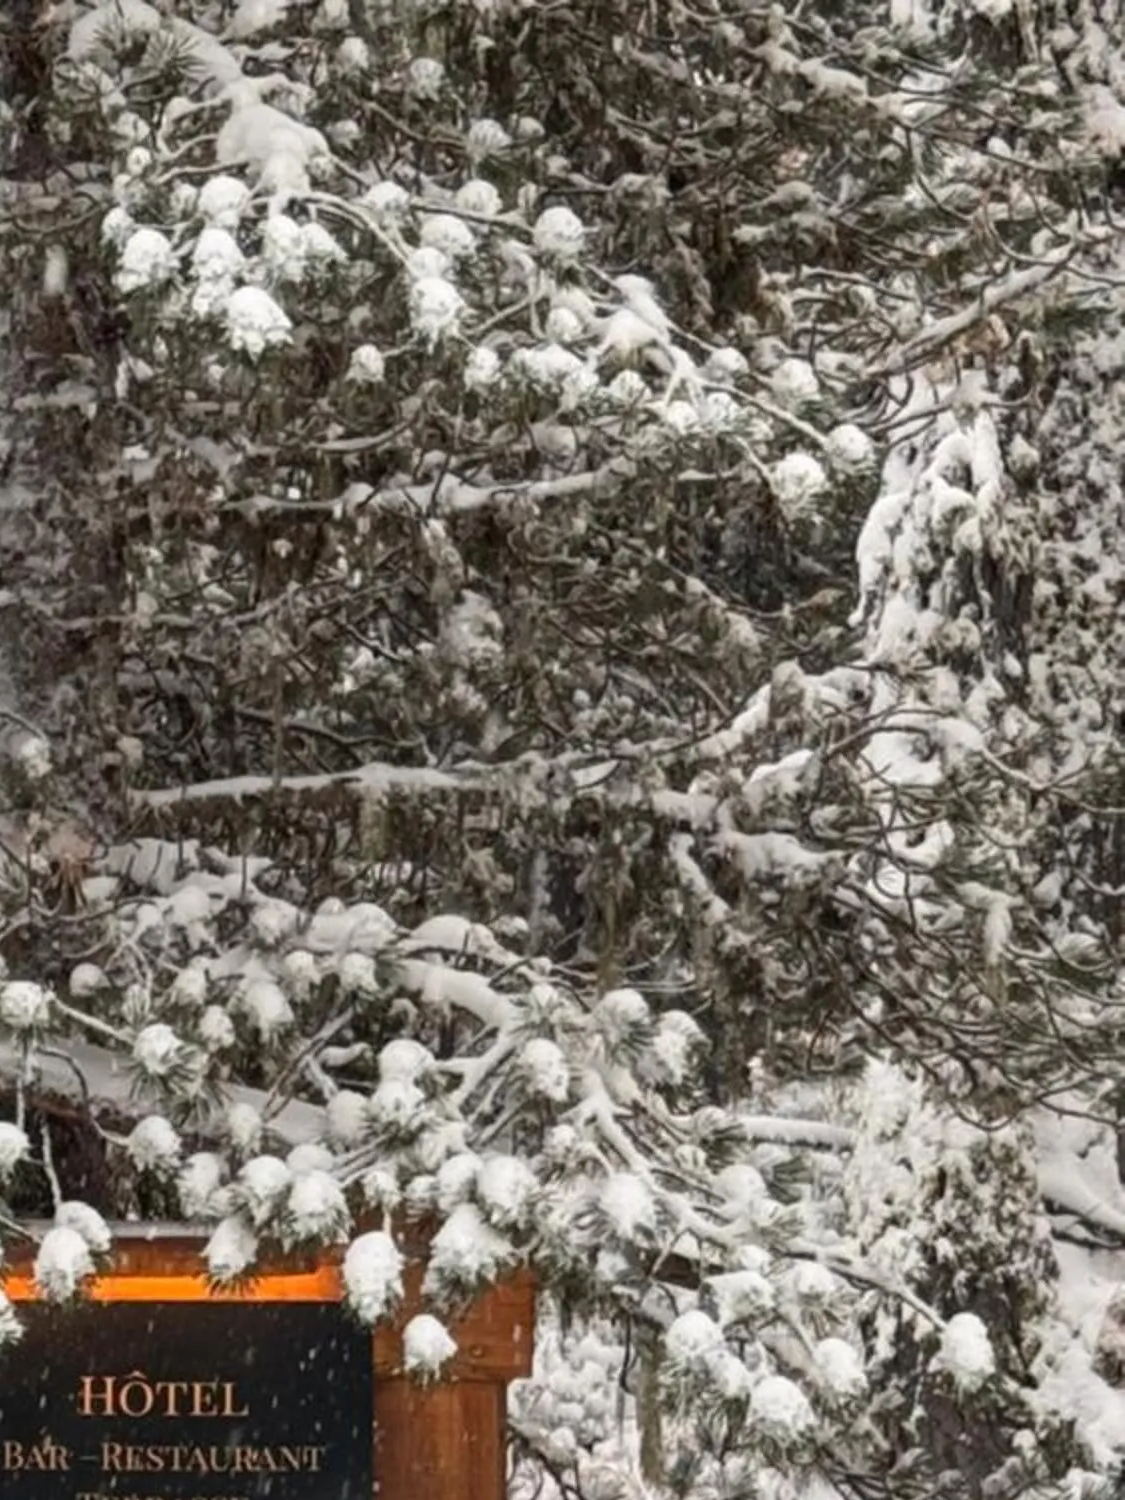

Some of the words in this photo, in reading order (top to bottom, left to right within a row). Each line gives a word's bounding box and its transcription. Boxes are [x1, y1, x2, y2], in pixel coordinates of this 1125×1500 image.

[78, 1370, 250, 1417] HÔTEL
[2, 1438, 71, 1471] BAR
[101, 1441, 324, 1472] RESTAURANT
